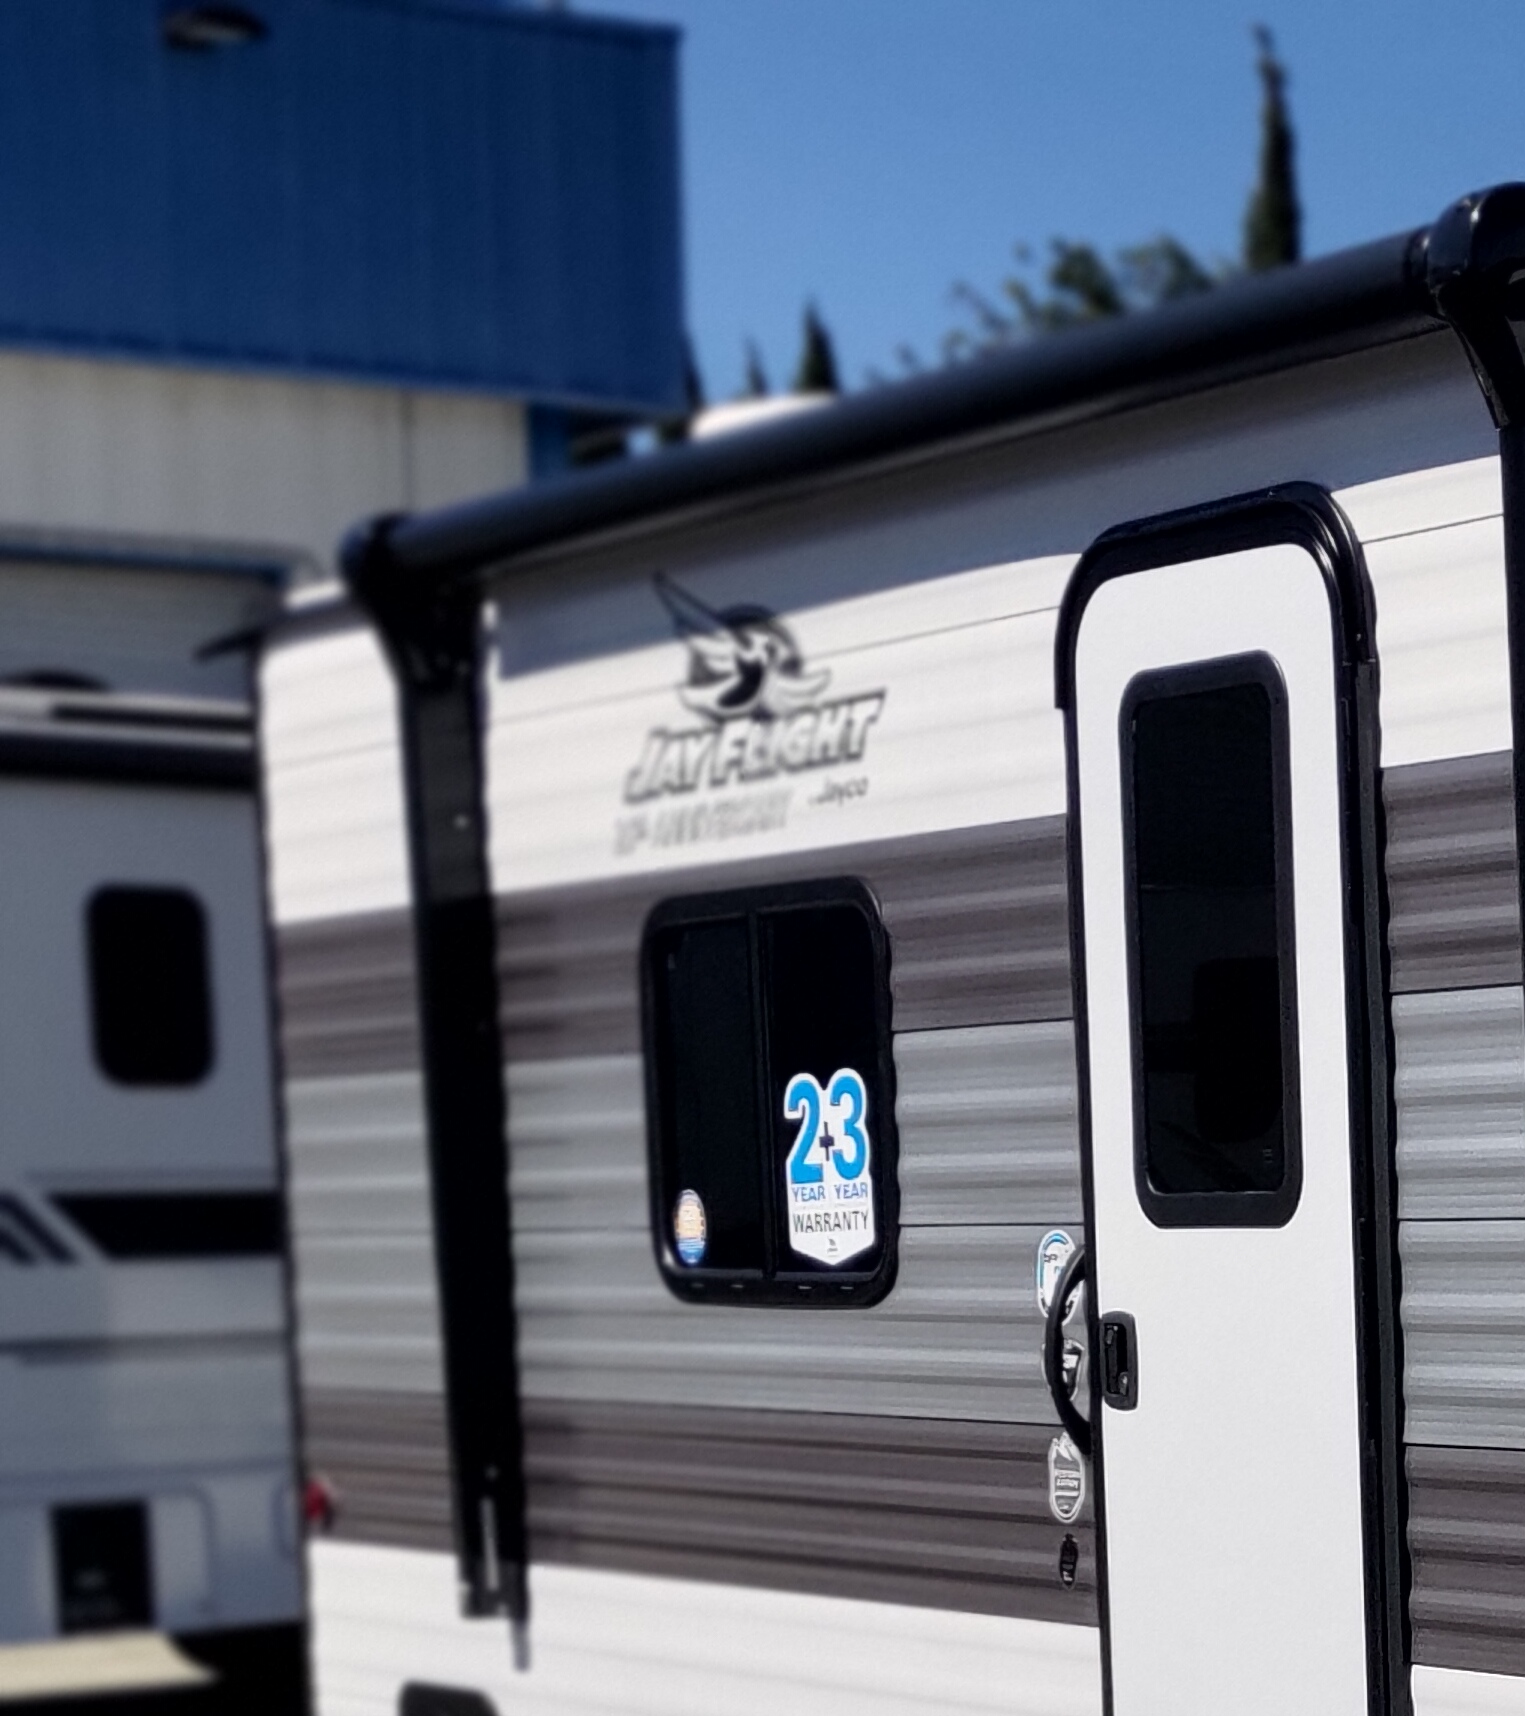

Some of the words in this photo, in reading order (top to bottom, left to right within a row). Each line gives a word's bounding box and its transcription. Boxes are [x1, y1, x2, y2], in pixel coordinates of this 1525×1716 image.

[621, 725, 718, 804] JAY
[710, 688, 887, 787] FLIGHT
[791, 1185, 827, 1203] YEAR
[833, 1181, 869, 1201] YEAR
[792, 1210, 870, 1235] WARRANTY
